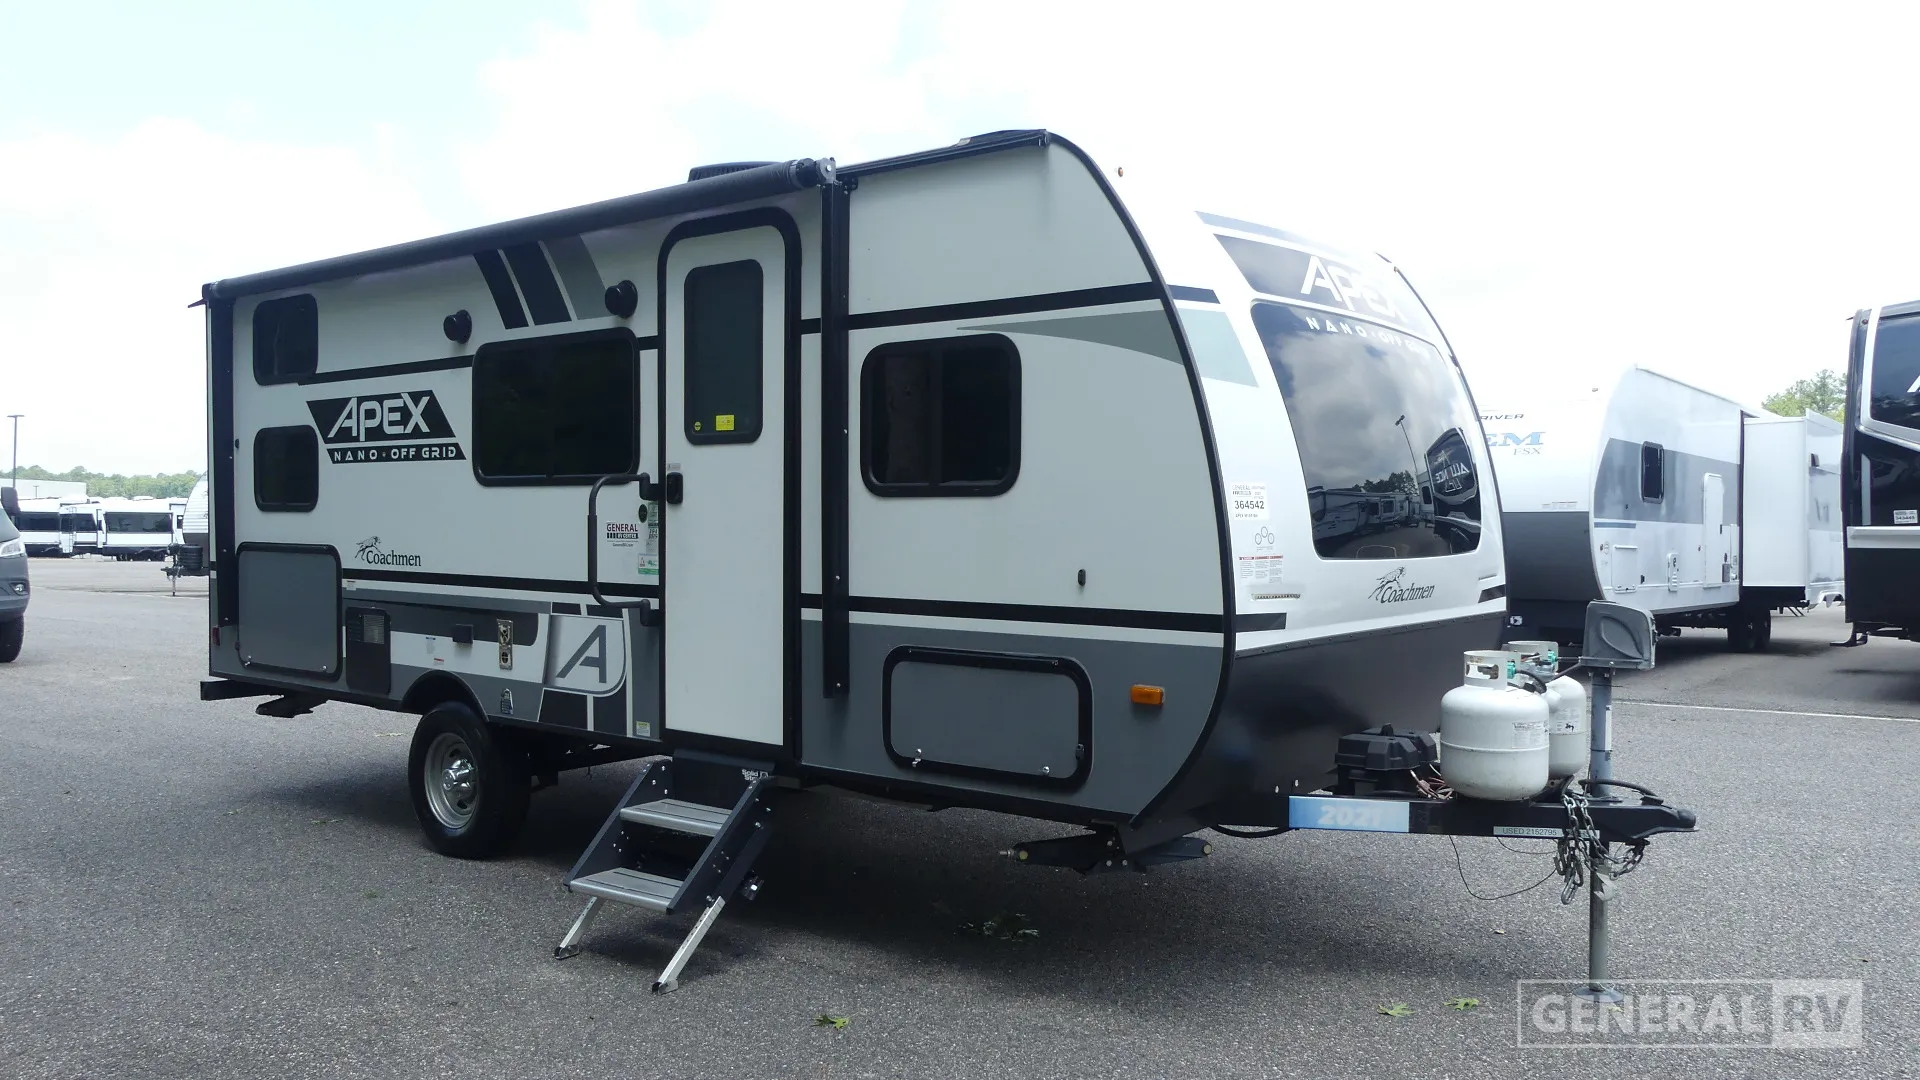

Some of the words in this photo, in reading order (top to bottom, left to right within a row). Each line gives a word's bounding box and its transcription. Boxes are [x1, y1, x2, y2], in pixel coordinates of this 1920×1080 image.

[1305, 316, 1367, 338] NANO
[327, 392, 430, 441] APEX
[334, 450, 378, 461] NANO
[390, 448, 416, 459] OFF
[421, 446, 456, 458] GRID
[1234, 500, 1265, 510] 364542
[606, 523, 639, 532] GENERAL
[366, 550, 422, 567] Coachmen
[1380, 582, 1436, 604] Coachmen
[1502, 827, 1524, 835] USED
[1526, 828, 1557, 836] 2152795
